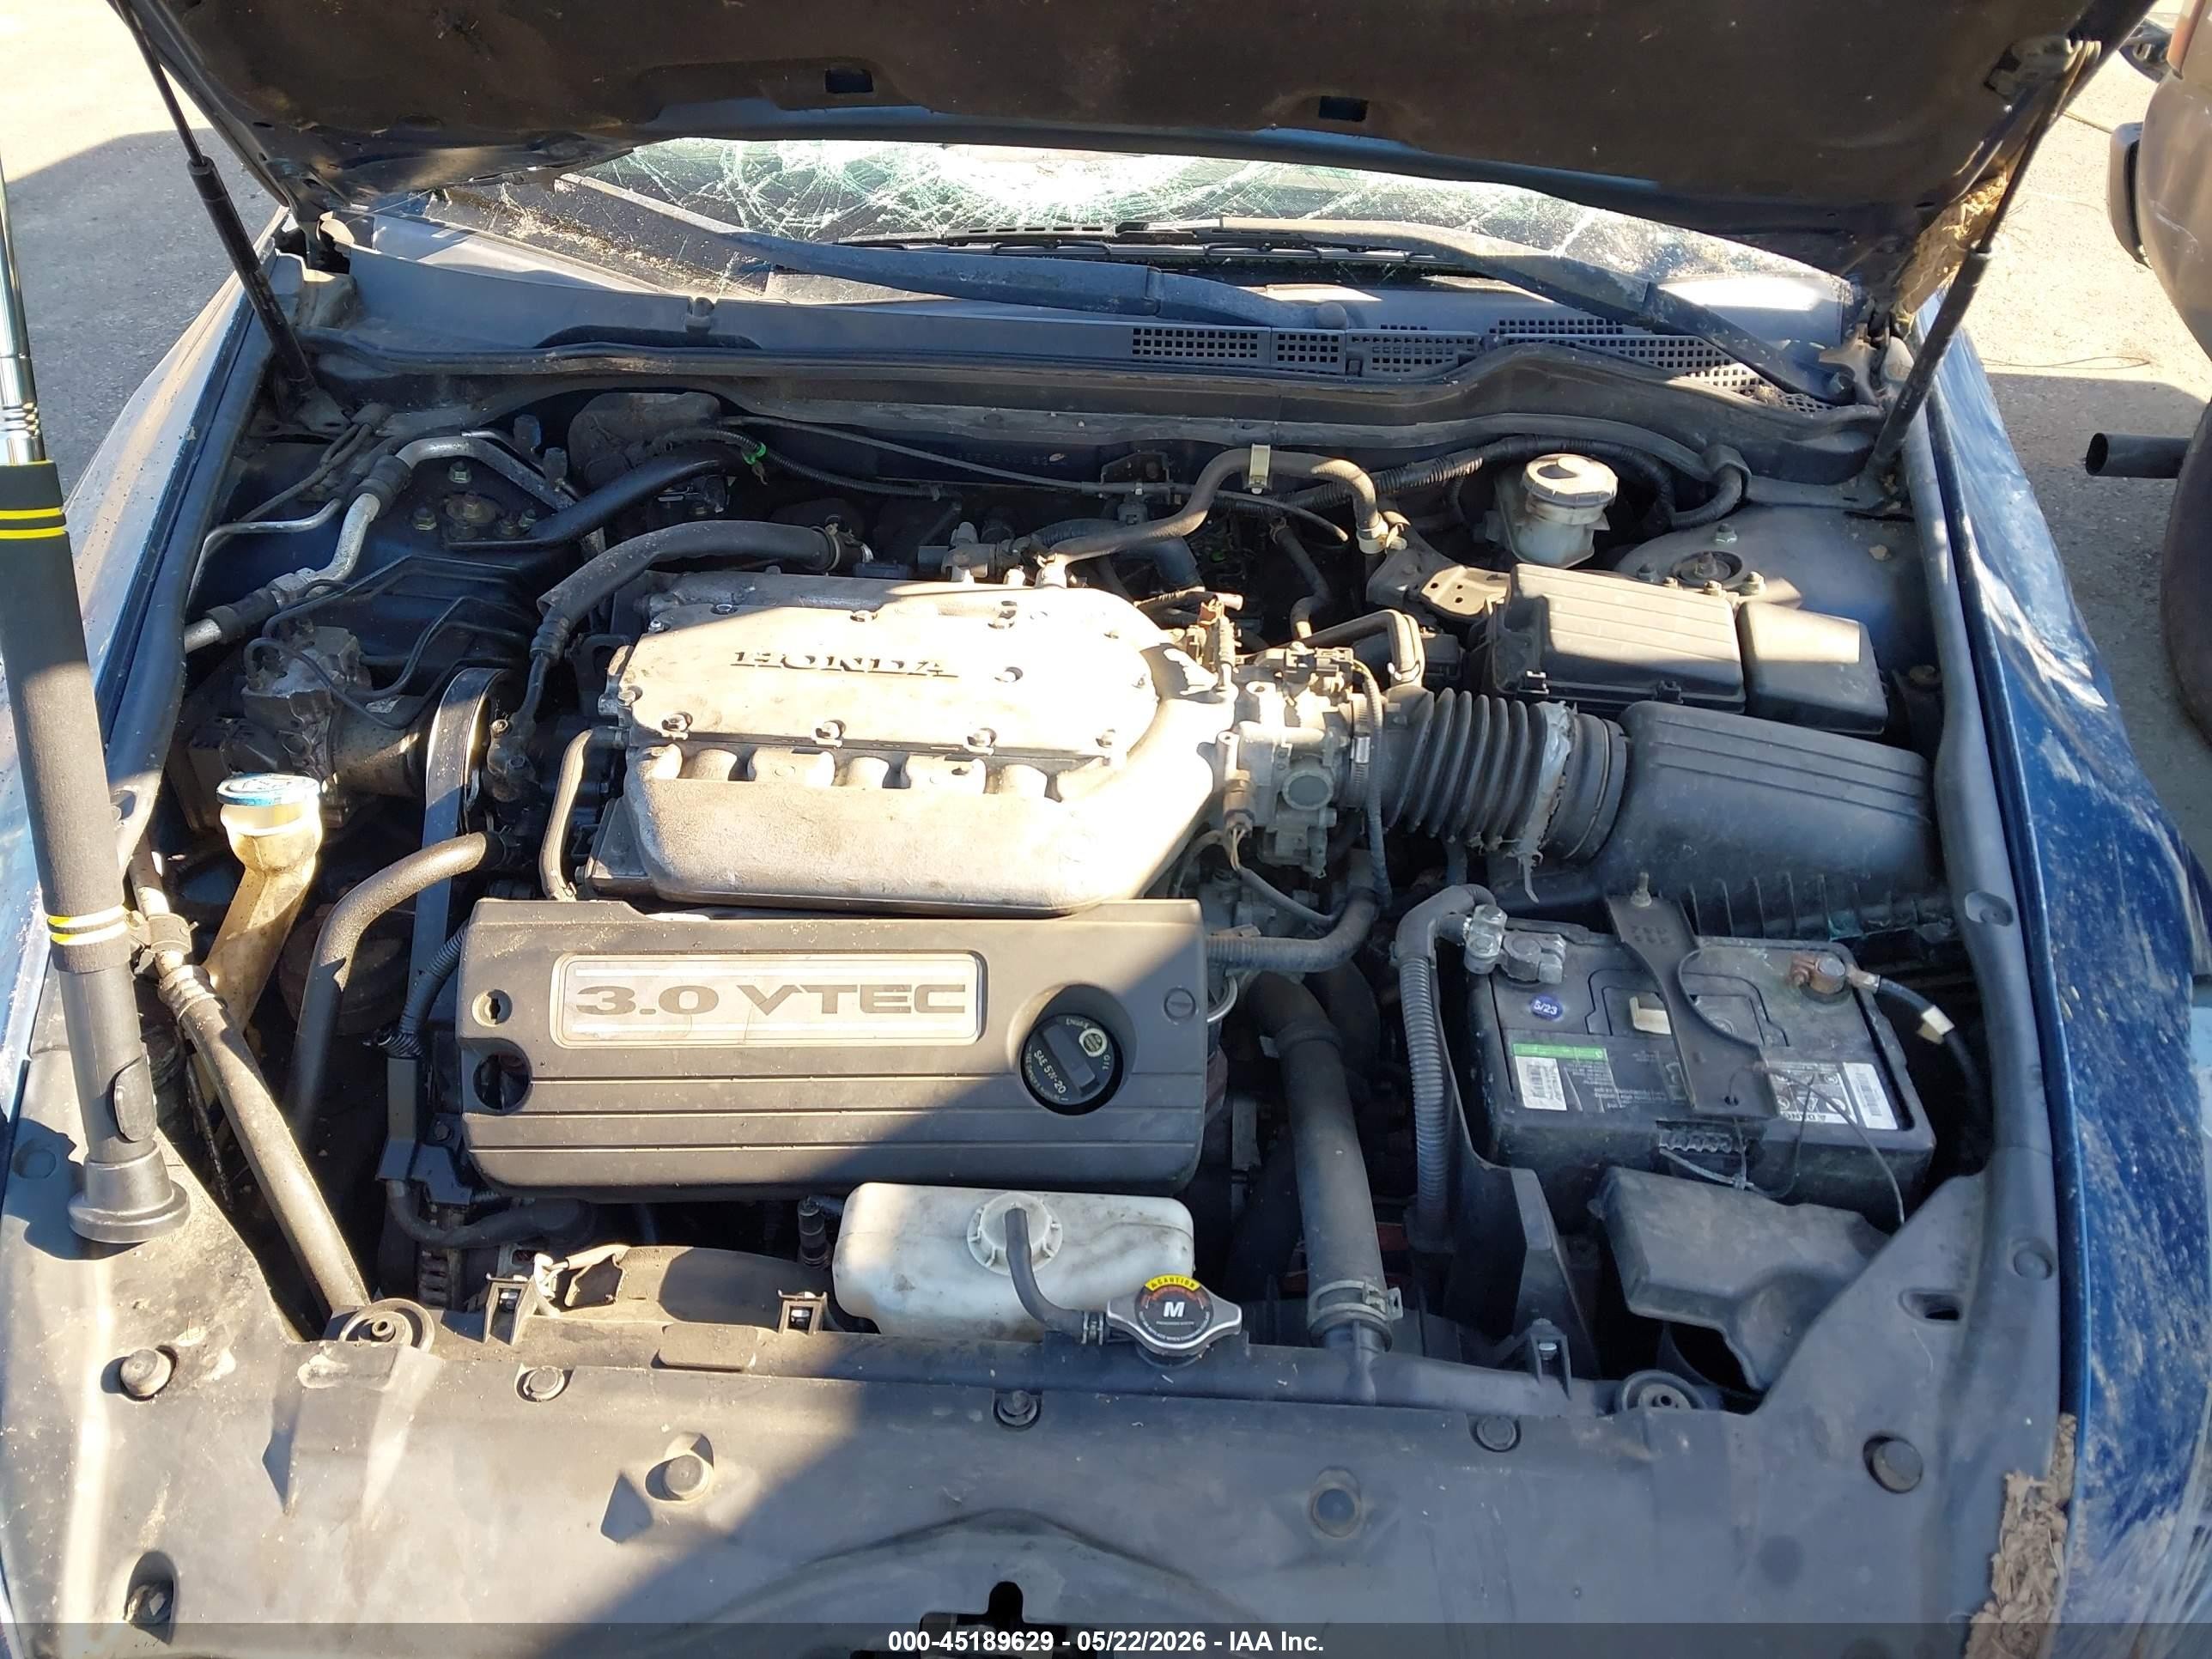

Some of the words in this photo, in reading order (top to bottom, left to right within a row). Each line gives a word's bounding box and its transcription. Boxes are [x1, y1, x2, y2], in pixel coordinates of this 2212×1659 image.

[729, 650, 960, 678] HONDA
[575, 984, 720, 1016] 3.0
[735, 983, 967, 1016] VTEC
[1533, 1000, 1559, 1016] 5/23
[1034, 1049, 1048, 1066] SAE
[1043, 1065, 1066, 1094] 5W-20
[1158, 1276, 1194, 1288] CAUTION
[1163, 1301, 1186, 1318] M
